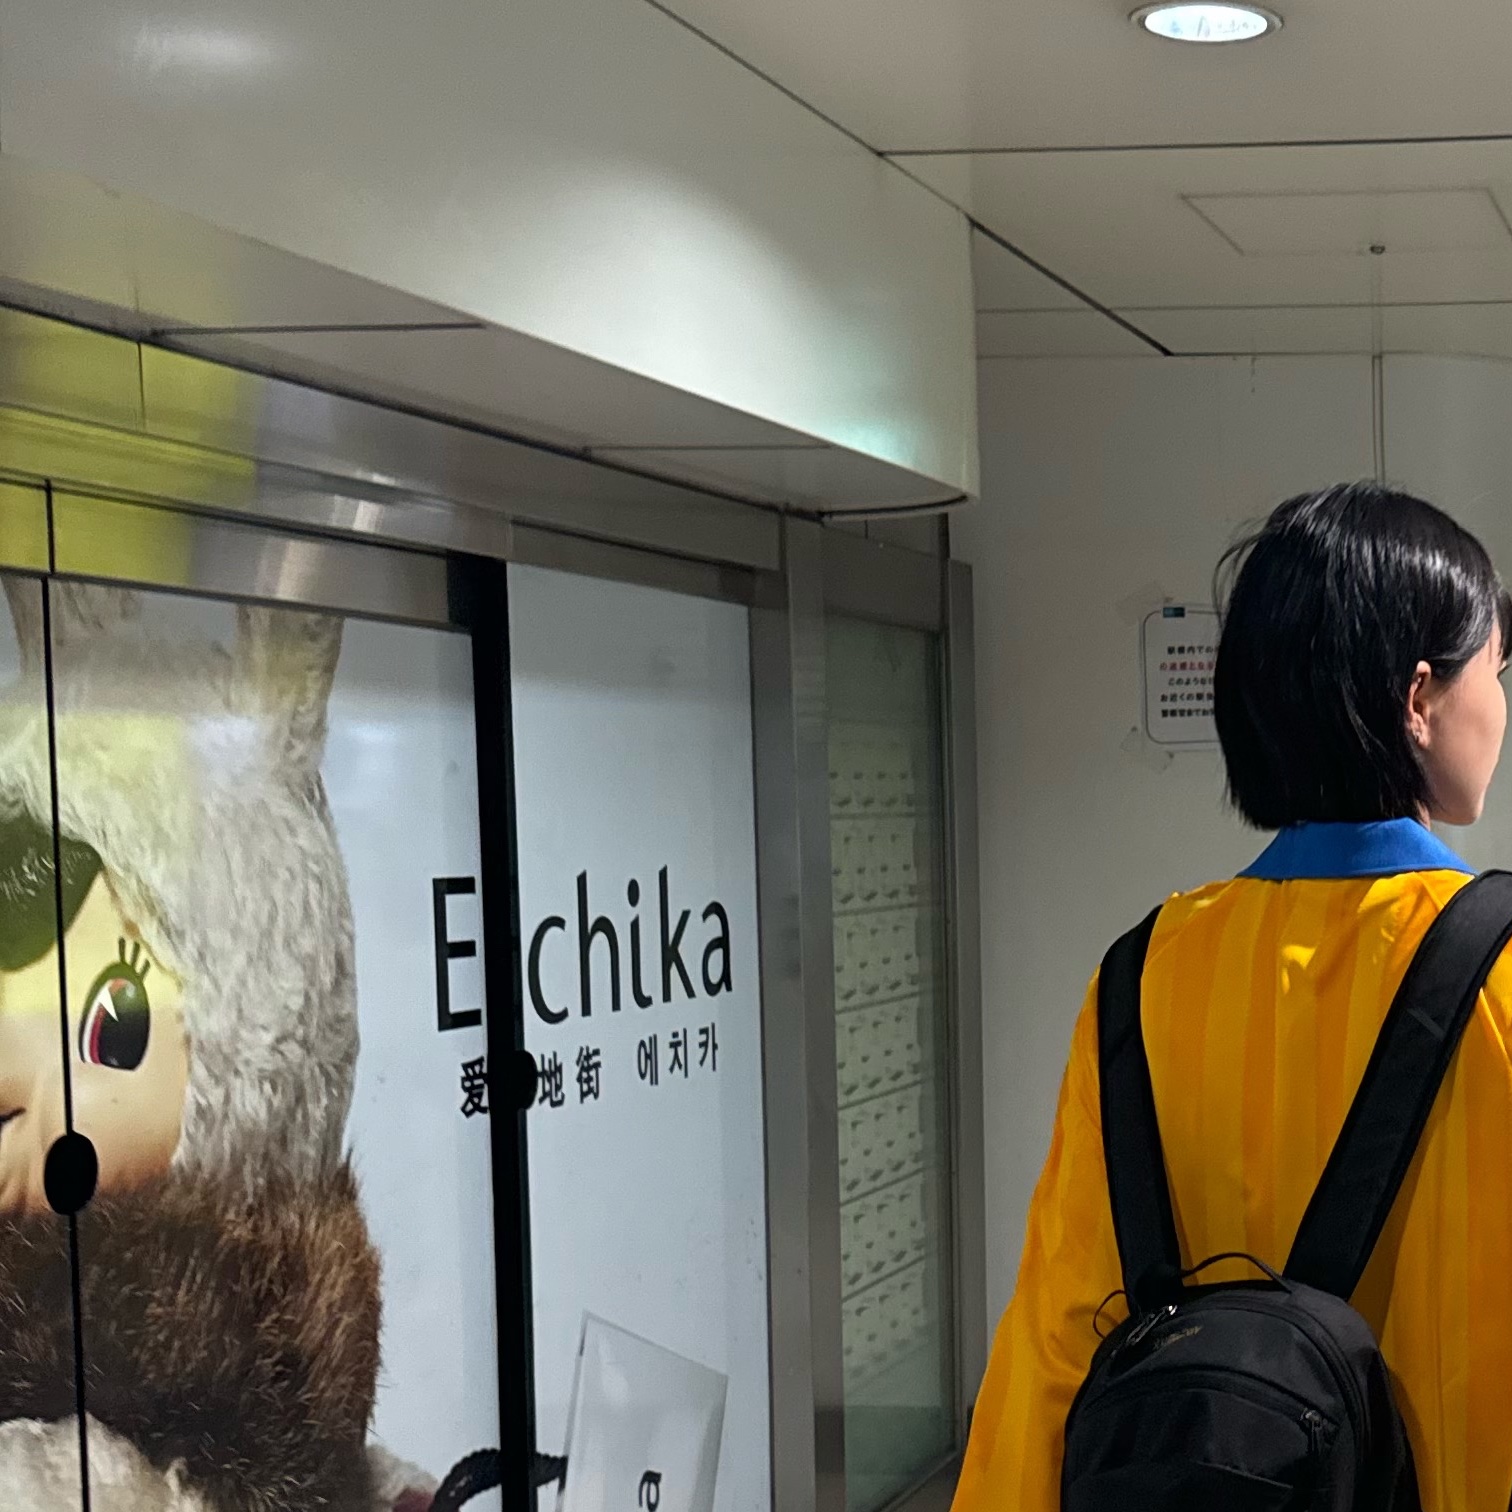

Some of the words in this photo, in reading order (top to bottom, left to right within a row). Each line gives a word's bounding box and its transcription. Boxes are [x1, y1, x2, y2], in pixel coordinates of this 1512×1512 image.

[432, 864, 733, 1032] Echika
[460, 1045, 602, 1119] 爱地街
[637, 1022, 719, 1086] 에치카
